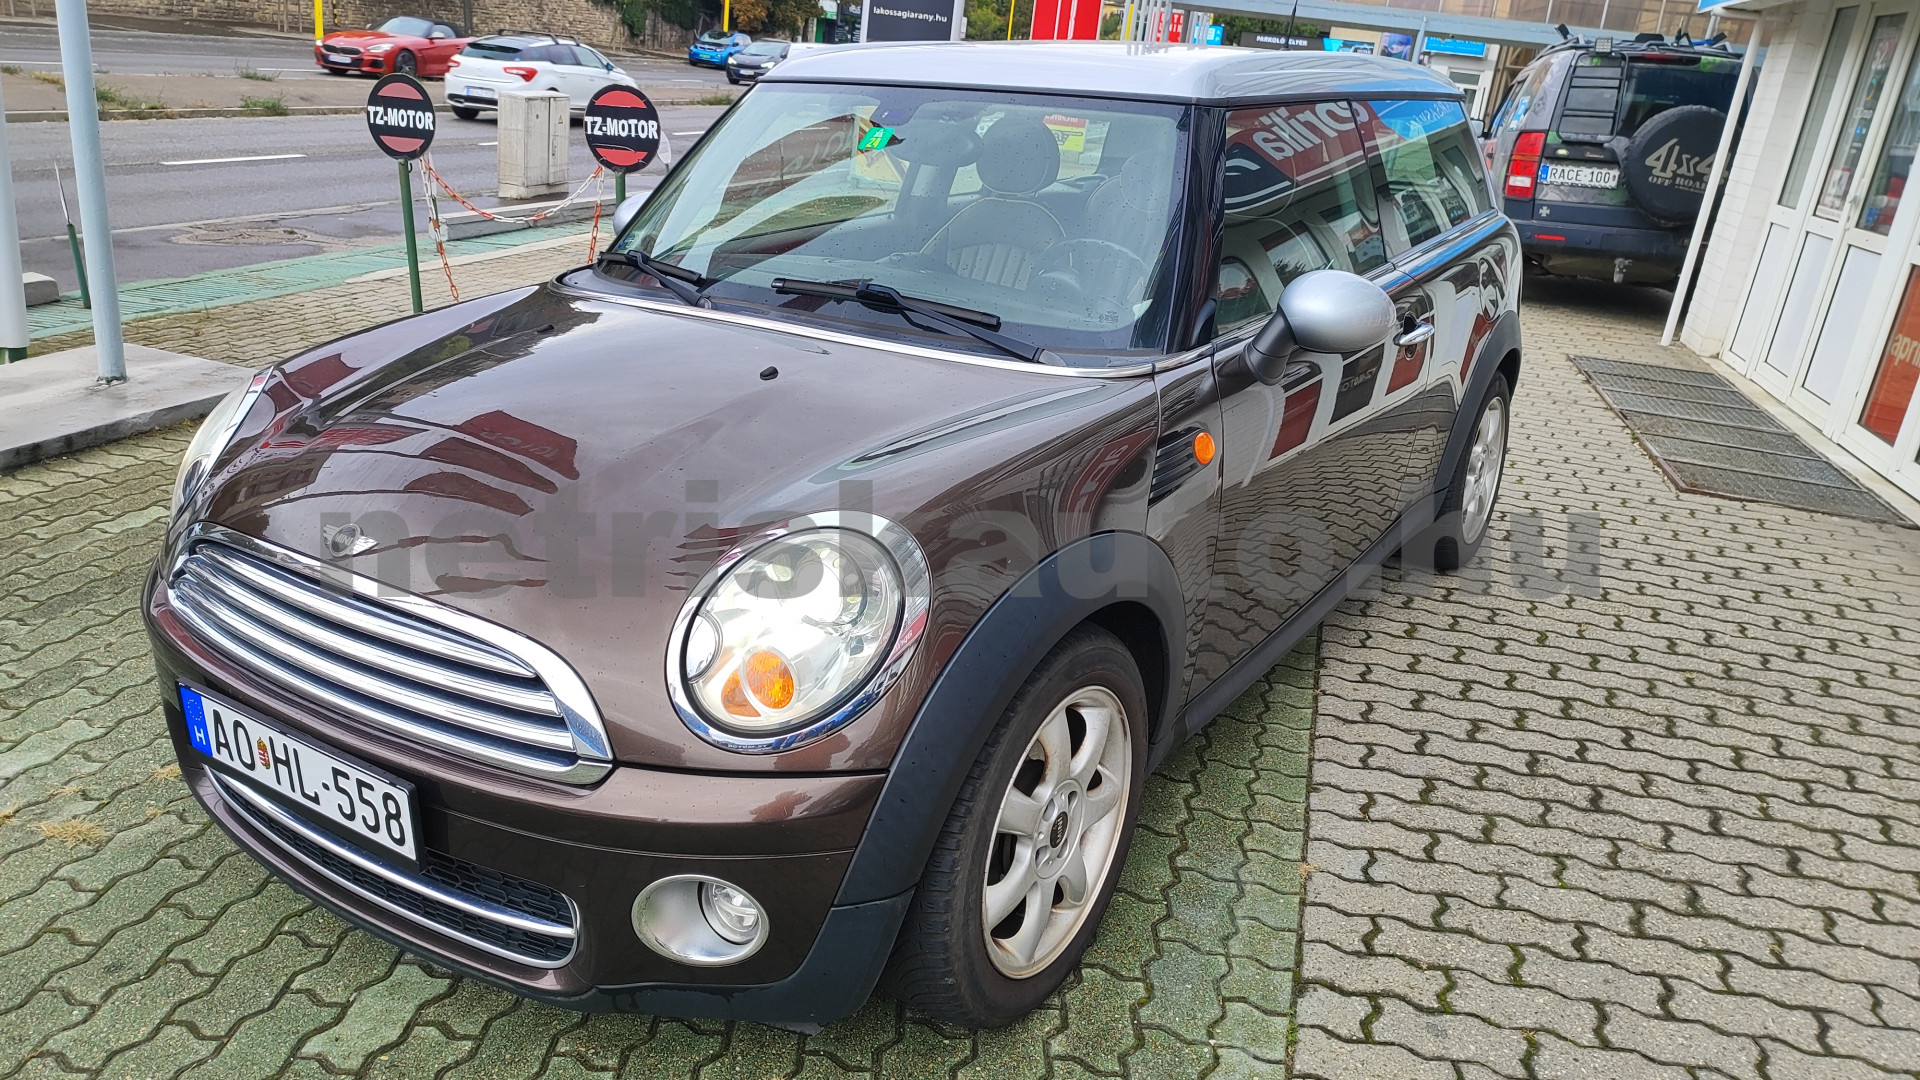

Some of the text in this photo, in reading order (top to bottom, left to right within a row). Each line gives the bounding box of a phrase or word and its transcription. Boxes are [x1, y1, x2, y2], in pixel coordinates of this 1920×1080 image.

[873, 6, 948, 23] lakossagiarany.hu
[367, 105, 434, 131] TZ-MOTOR
[584, 115, 659, 140] TZ-MOTOR
[1549, 167, 1611, 184] RACE-100
[1648, 175, 1673, 187] OFF
[193, 725, 207, 746] H
[212, 708, 256, 772] AO
